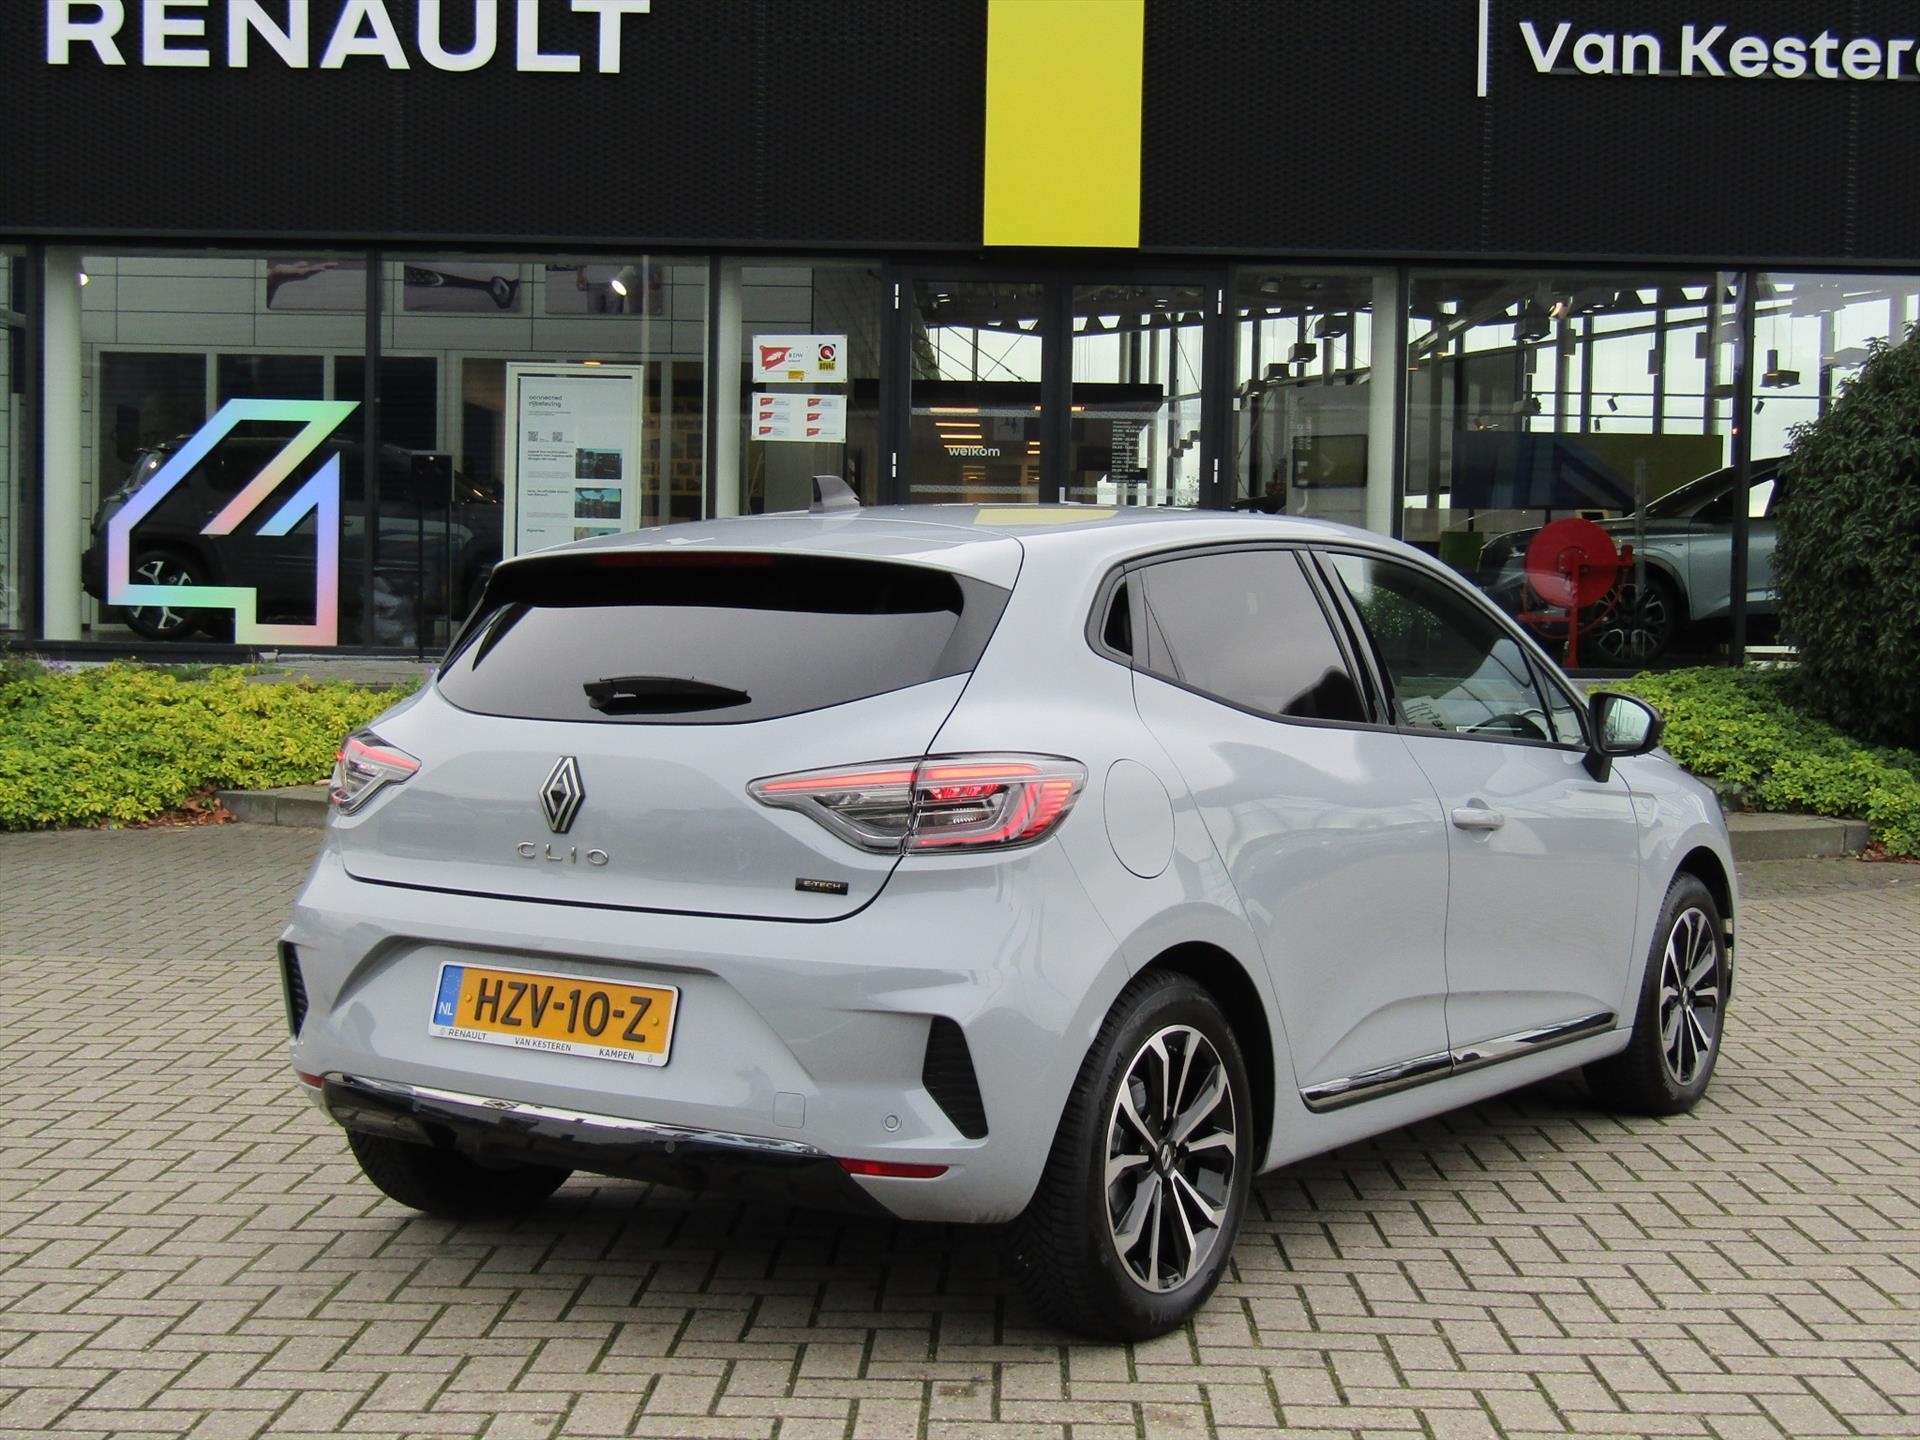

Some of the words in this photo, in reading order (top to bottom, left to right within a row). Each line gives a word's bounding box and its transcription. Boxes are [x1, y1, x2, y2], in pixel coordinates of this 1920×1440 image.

[46, 0, 650, 73] RENAULT
[1519, 21, 1661, 76] Van
[1680, 24, 1920, 80] Kester
[948, 446, 1001, 457] welkom
[517, 841, 609, 866] CLIO
[439, 1001, 453, 1017] NL
[474, 978, 653, 1042] HZV-10-Z
[448, 1028, 487, 1041] RENAULT
[514, 1037, 531, 1047] VAN
[532, 1039, 572, 1052] KESTEREN
[599, 1048, 635, 1060] KAMPEN
